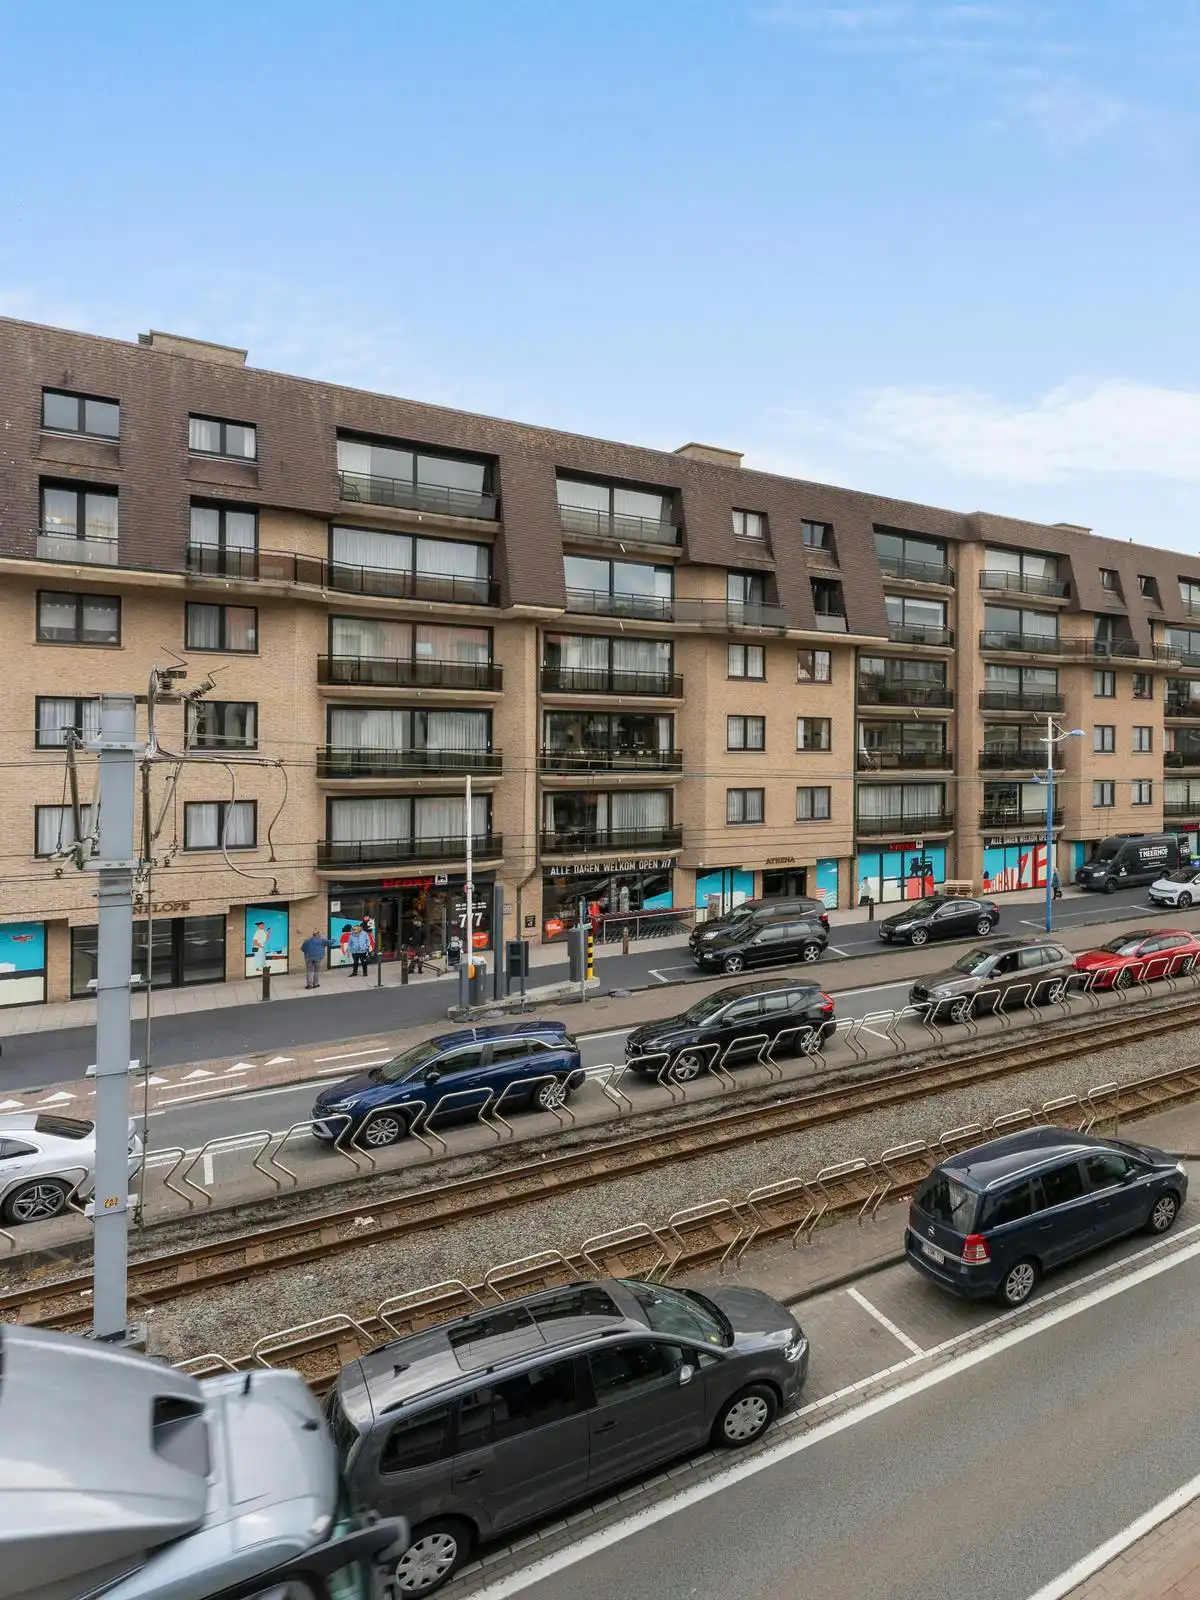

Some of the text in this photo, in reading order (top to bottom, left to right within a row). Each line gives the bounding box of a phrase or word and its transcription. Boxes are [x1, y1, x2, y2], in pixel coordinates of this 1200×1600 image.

[990, 837, 1003, 845] ALLE
[550, 866, 571, 875] ALLE
[574, 864, 600, 874] DAGEN
[603, 860, 636, 872] WELKOM
[639, 859, 658, 869] OPEN
